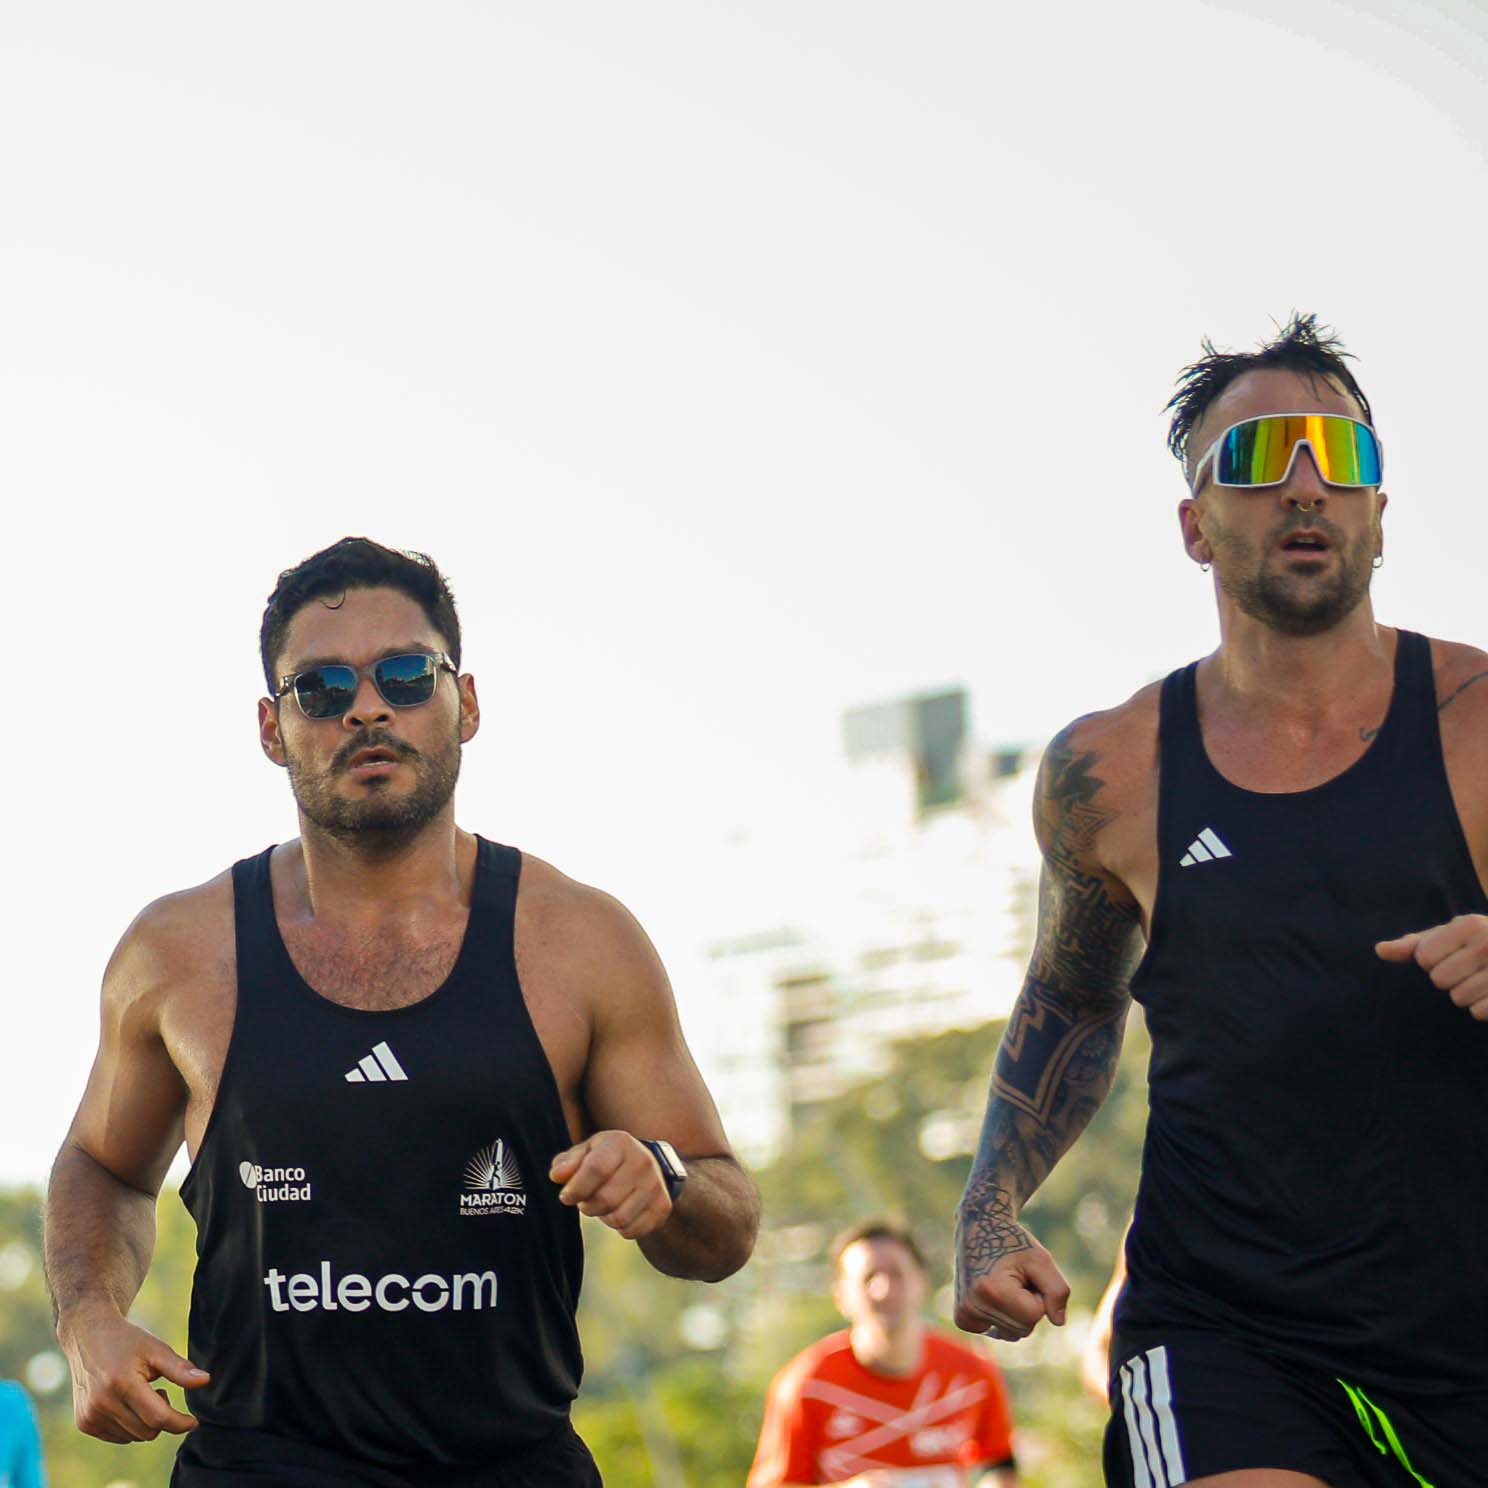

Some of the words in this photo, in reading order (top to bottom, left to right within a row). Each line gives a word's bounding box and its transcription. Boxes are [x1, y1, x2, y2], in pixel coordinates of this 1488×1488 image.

[254, 1165, 306, 1183] Banco
[256, 1183, 311, 1202] Ciudad
[460, 1192, 527, 1207] MARATON
[263, 1260, 498, 1313] telecom
